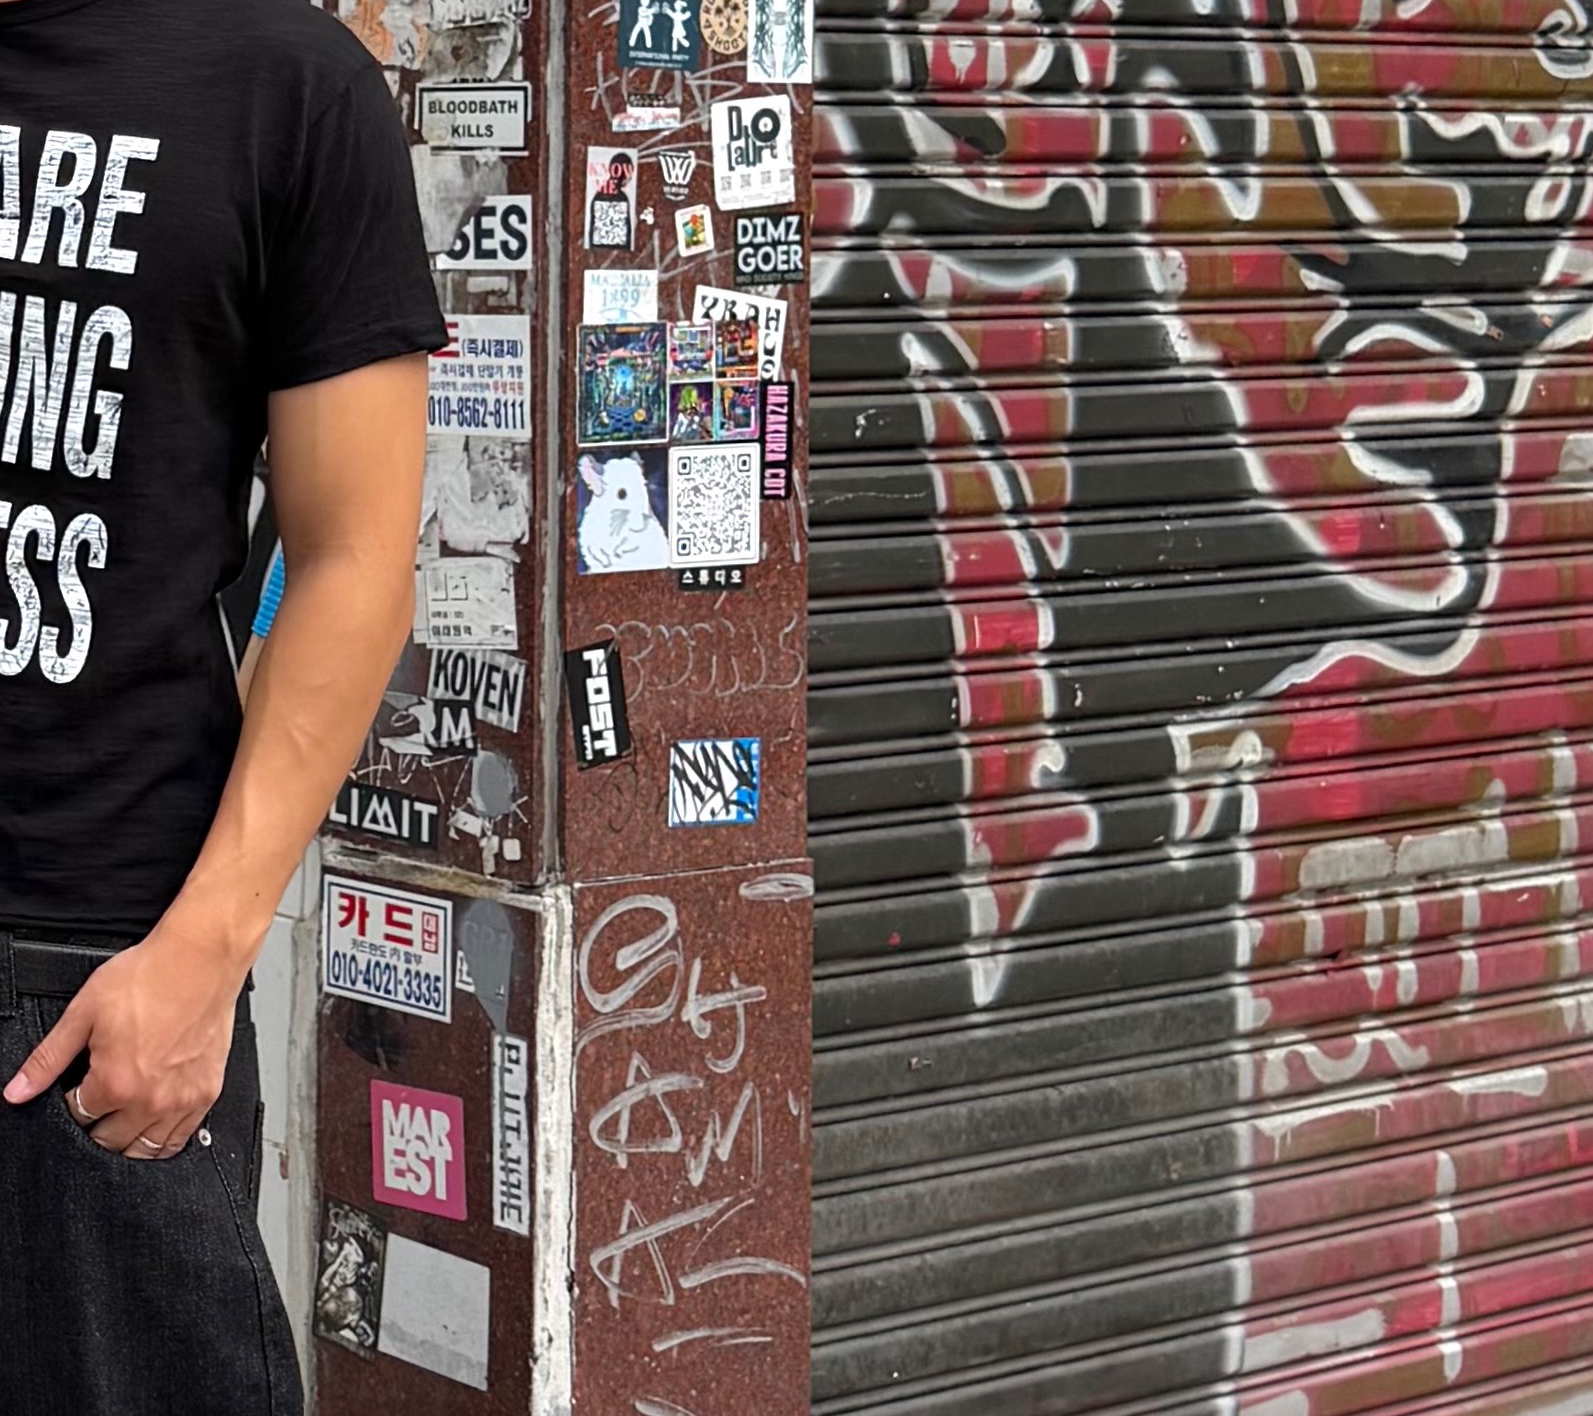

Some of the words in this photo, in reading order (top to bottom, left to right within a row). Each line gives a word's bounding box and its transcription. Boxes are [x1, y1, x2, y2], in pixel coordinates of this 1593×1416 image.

[428, 100, 518, 115] BLOODBATH
[451, 124, 494, 138] KILLS
[737, 215, 800, 244] DIMZ
[738, 245, 803, 273] GOER
[428, 395, 525, 430] 010-8562-8111
[765, 385, 788, 461] HAZAKURA
[433, 649, 519, 718] KOVEN
[338, 891, 413, 947] 카드
[332, 950, 442, 1009] 010-4021-3335
